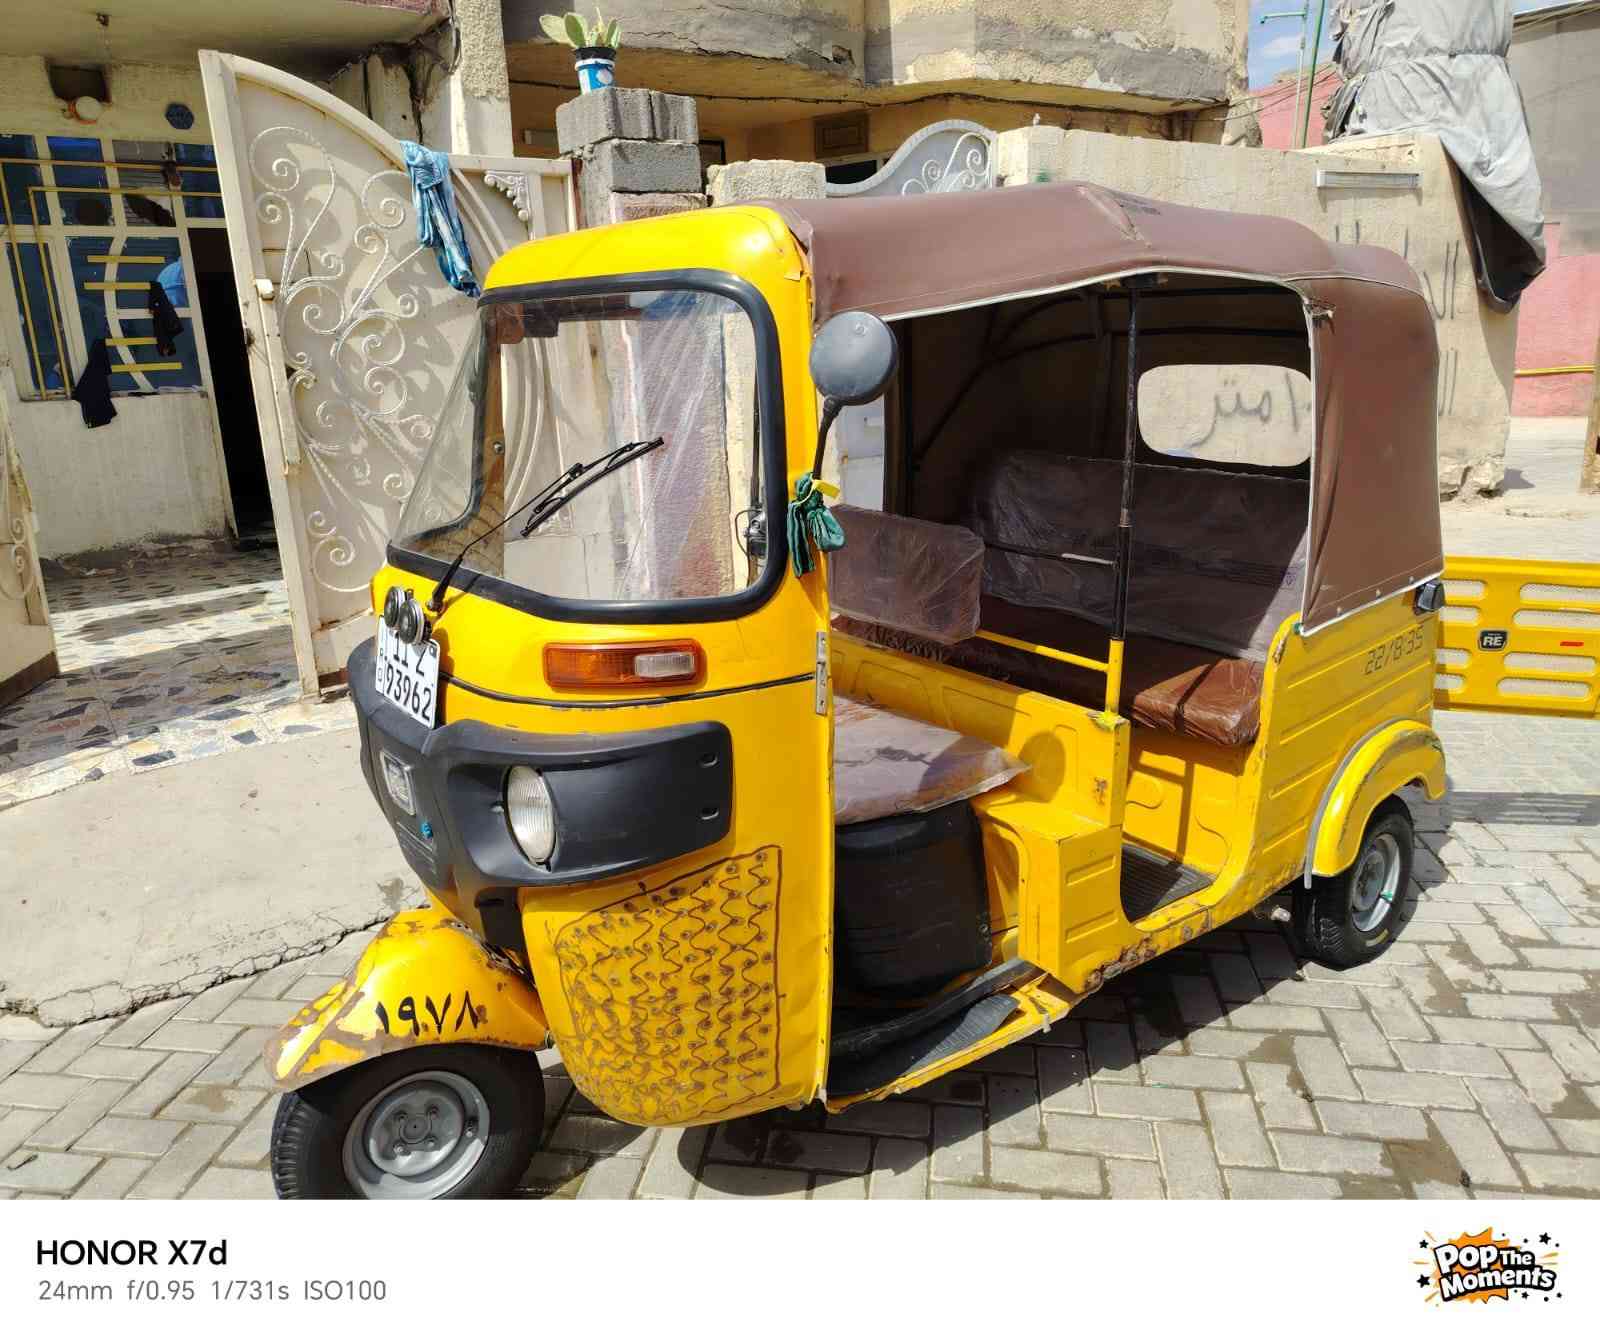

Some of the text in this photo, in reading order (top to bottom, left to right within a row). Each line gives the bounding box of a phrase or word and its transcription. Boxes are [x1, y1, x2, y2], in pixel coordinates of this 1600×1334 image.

[1482, 636, 1504, 647] RE
[386, 663, 432, 722] 93962
[375, 989, 480, 1037] ١٩٧٨
